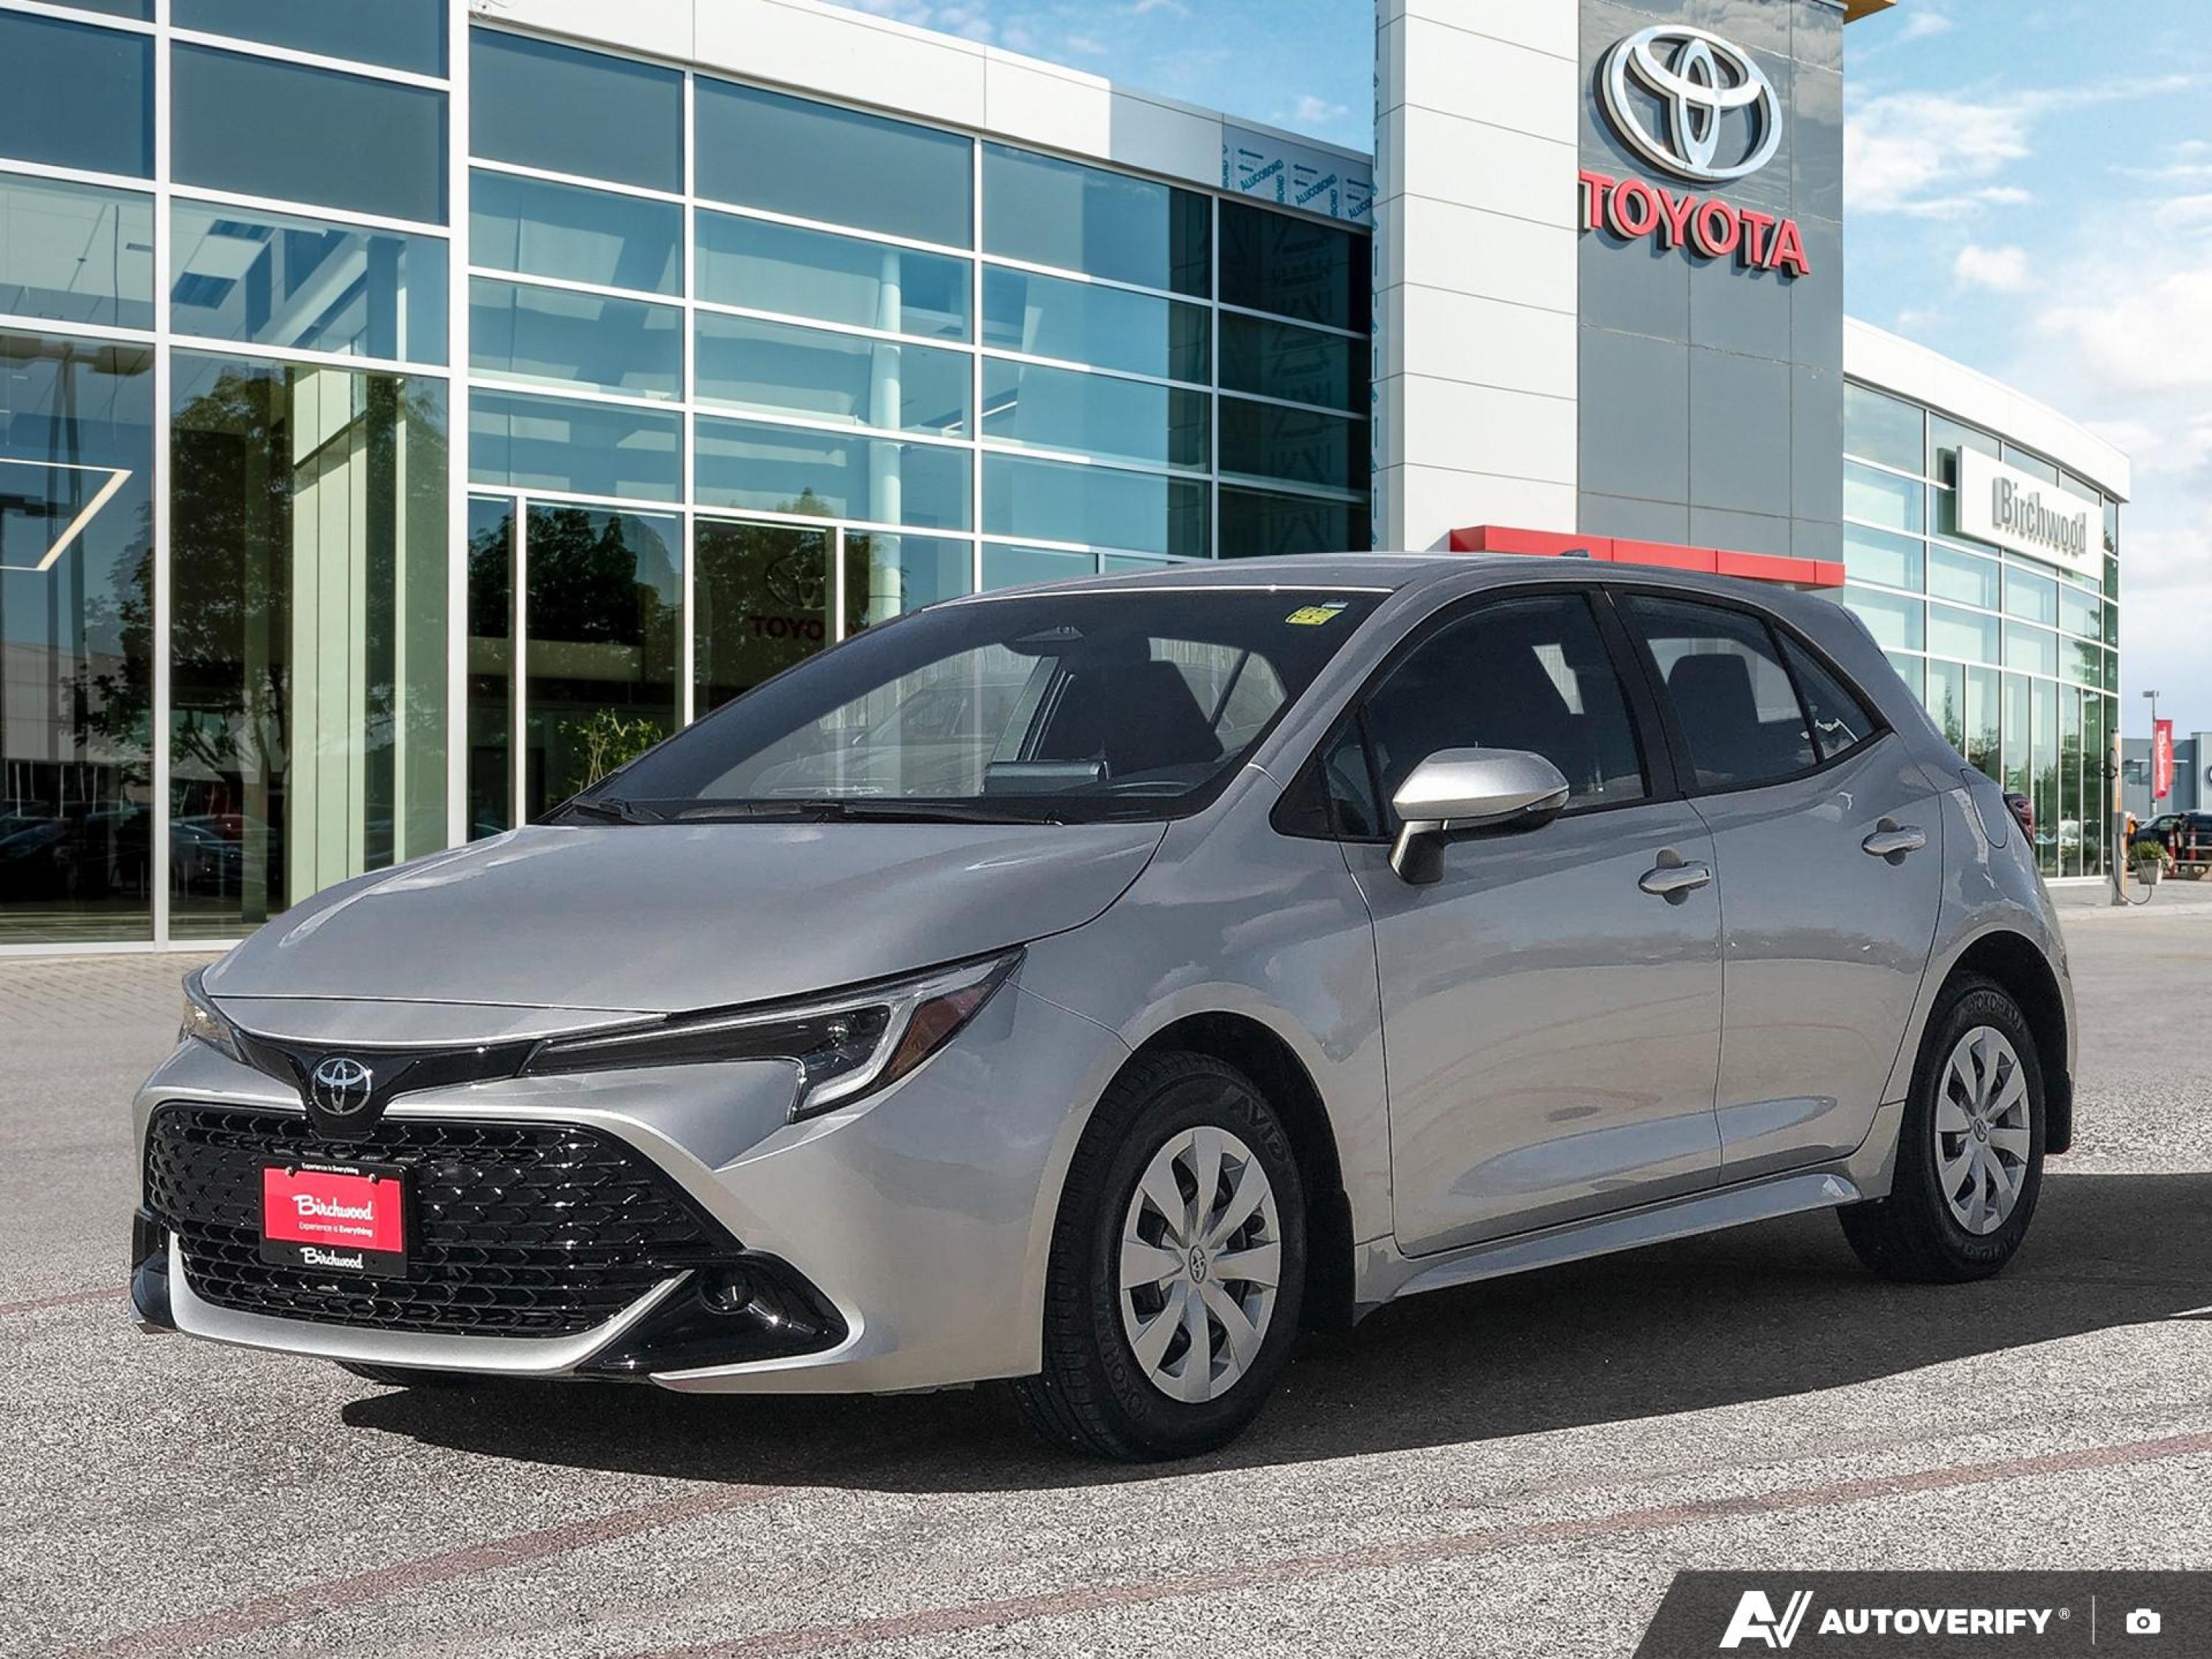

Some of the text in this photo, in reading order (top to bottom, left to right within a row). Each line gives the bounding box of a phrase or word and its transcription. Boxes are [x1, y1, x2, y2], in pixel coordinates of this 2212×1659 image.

[1240, 159, 1283, 192] ALUCOBOND
[1295, 174, 1337, 206] ALUCOBOND
[1579, 170, 1809, 275] TOYOTA
[1993, 477, 2087, 558] Birchwood
[748, 616, 825, 640] TOYO
[292, 1194, 374, 1220] Birchwood
[299, 1221, 332, 1232] Experience
[339, 1225, 373, 1238] Everything
[299, 1248, 364, 1269] Birchwood
